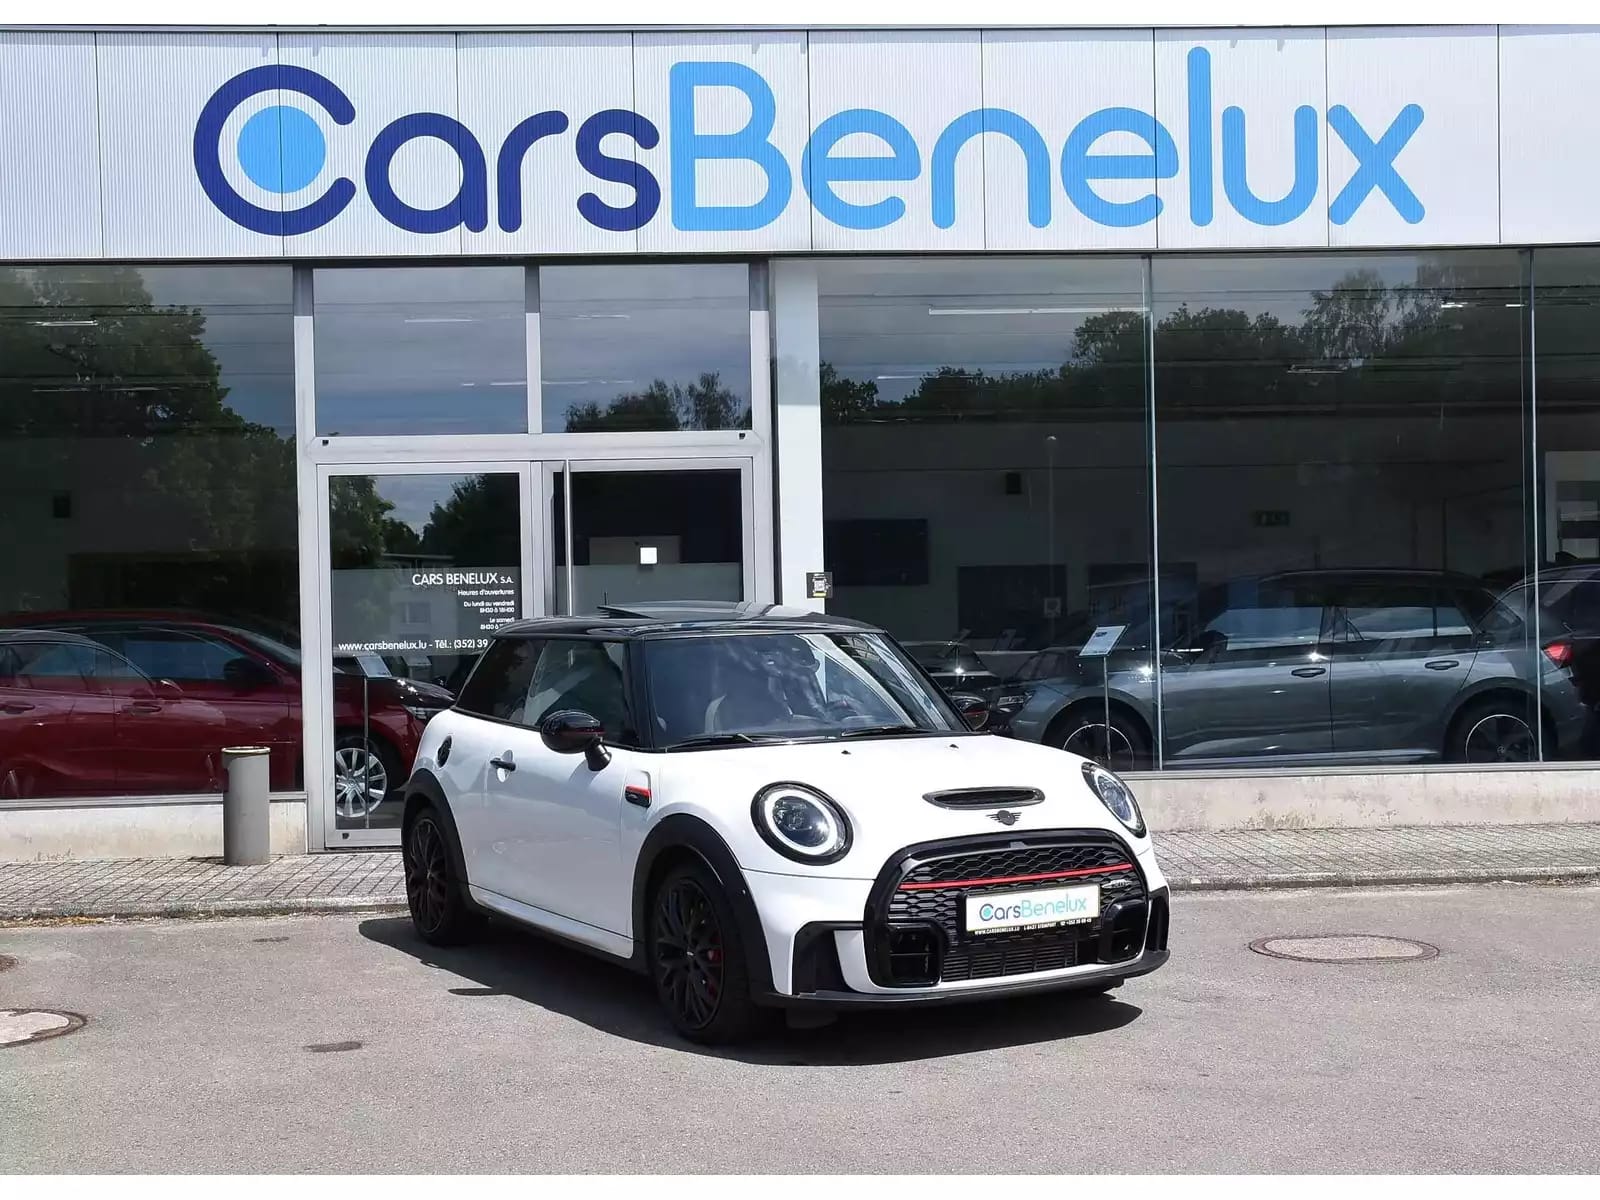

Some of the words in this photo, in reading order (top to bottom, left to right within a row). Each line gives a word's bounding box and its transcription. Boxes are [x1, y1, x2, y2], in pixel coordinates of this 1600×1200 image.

[412, 573, 443, 585] CARS
[446, 572, 498, 584] BENELUX
[500, 576, 514, 584] S.A.
[338, 640, 427, 651] www.carsbenelux.lu
[453, 639, 475, 649] (352)
[477, 639, 488, 648] 39
